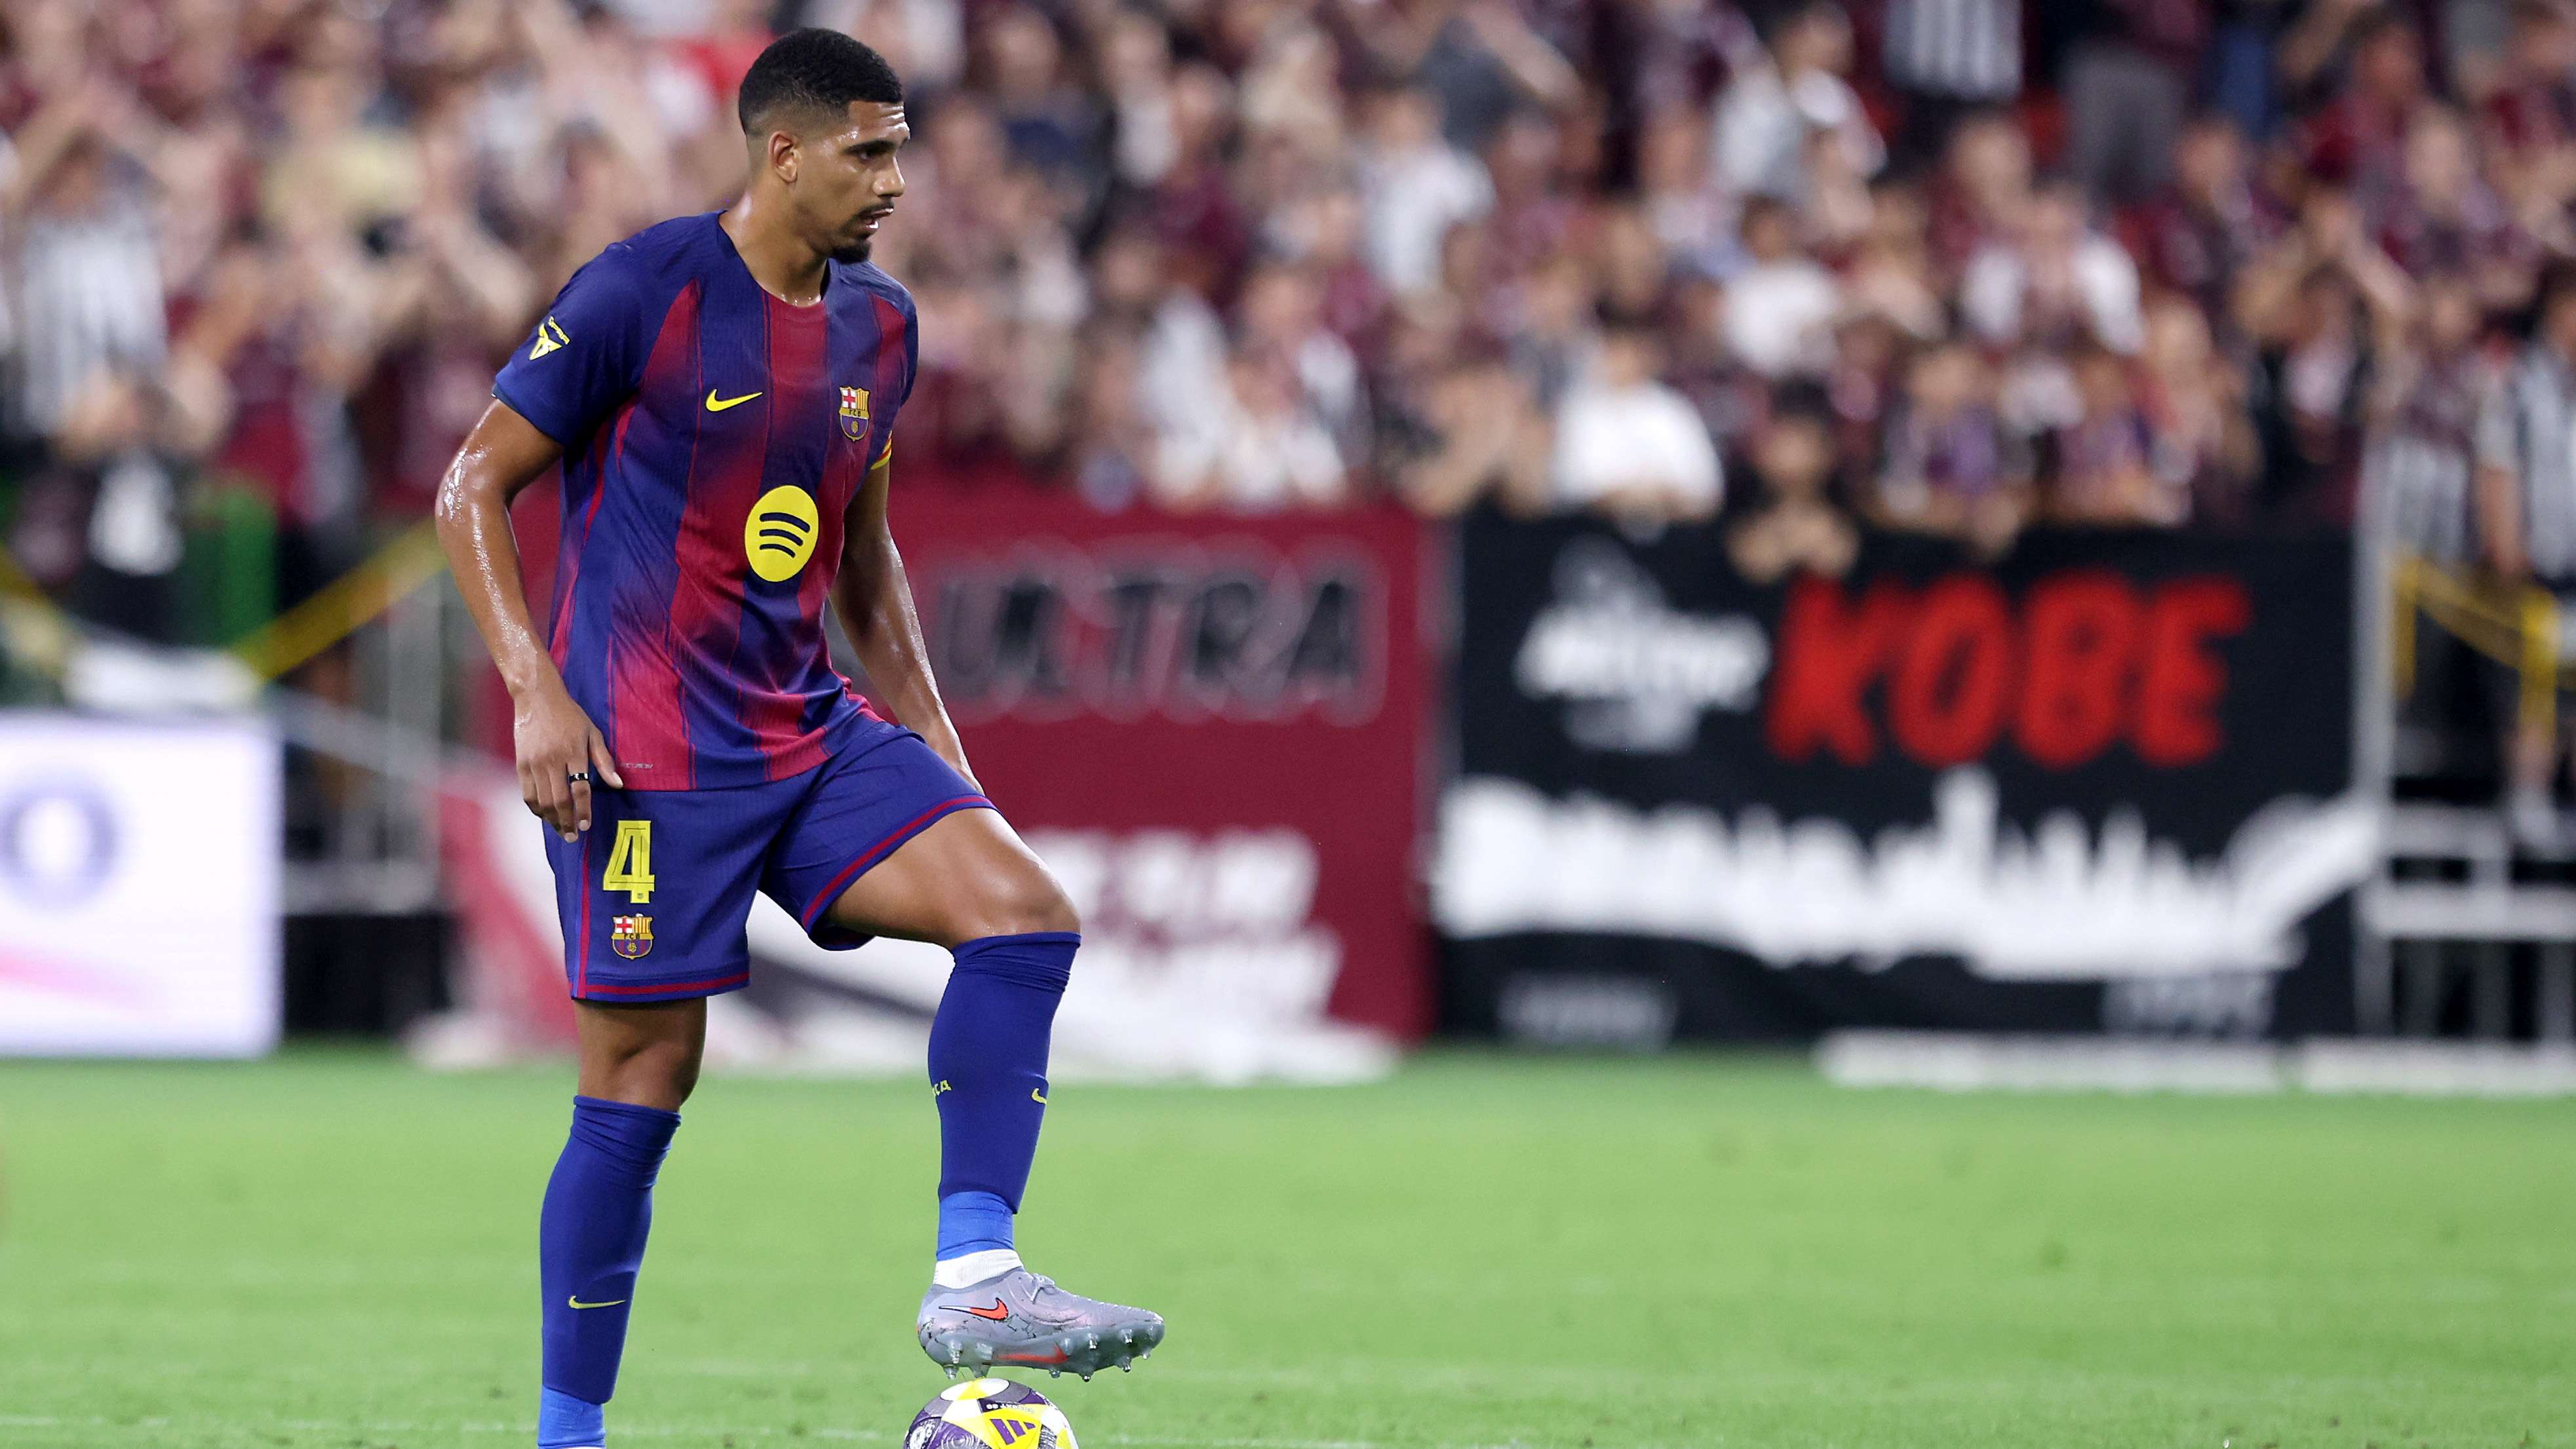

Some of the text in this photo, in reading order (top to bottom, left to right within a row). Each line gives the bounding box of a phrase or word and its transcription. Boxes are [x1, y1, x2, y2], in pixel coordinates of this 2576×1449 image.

[929, 554, 1373, 708] ULTRA
[1769, 568, 2250, 768] KOBE
[603, 819, 655, 904] 4
